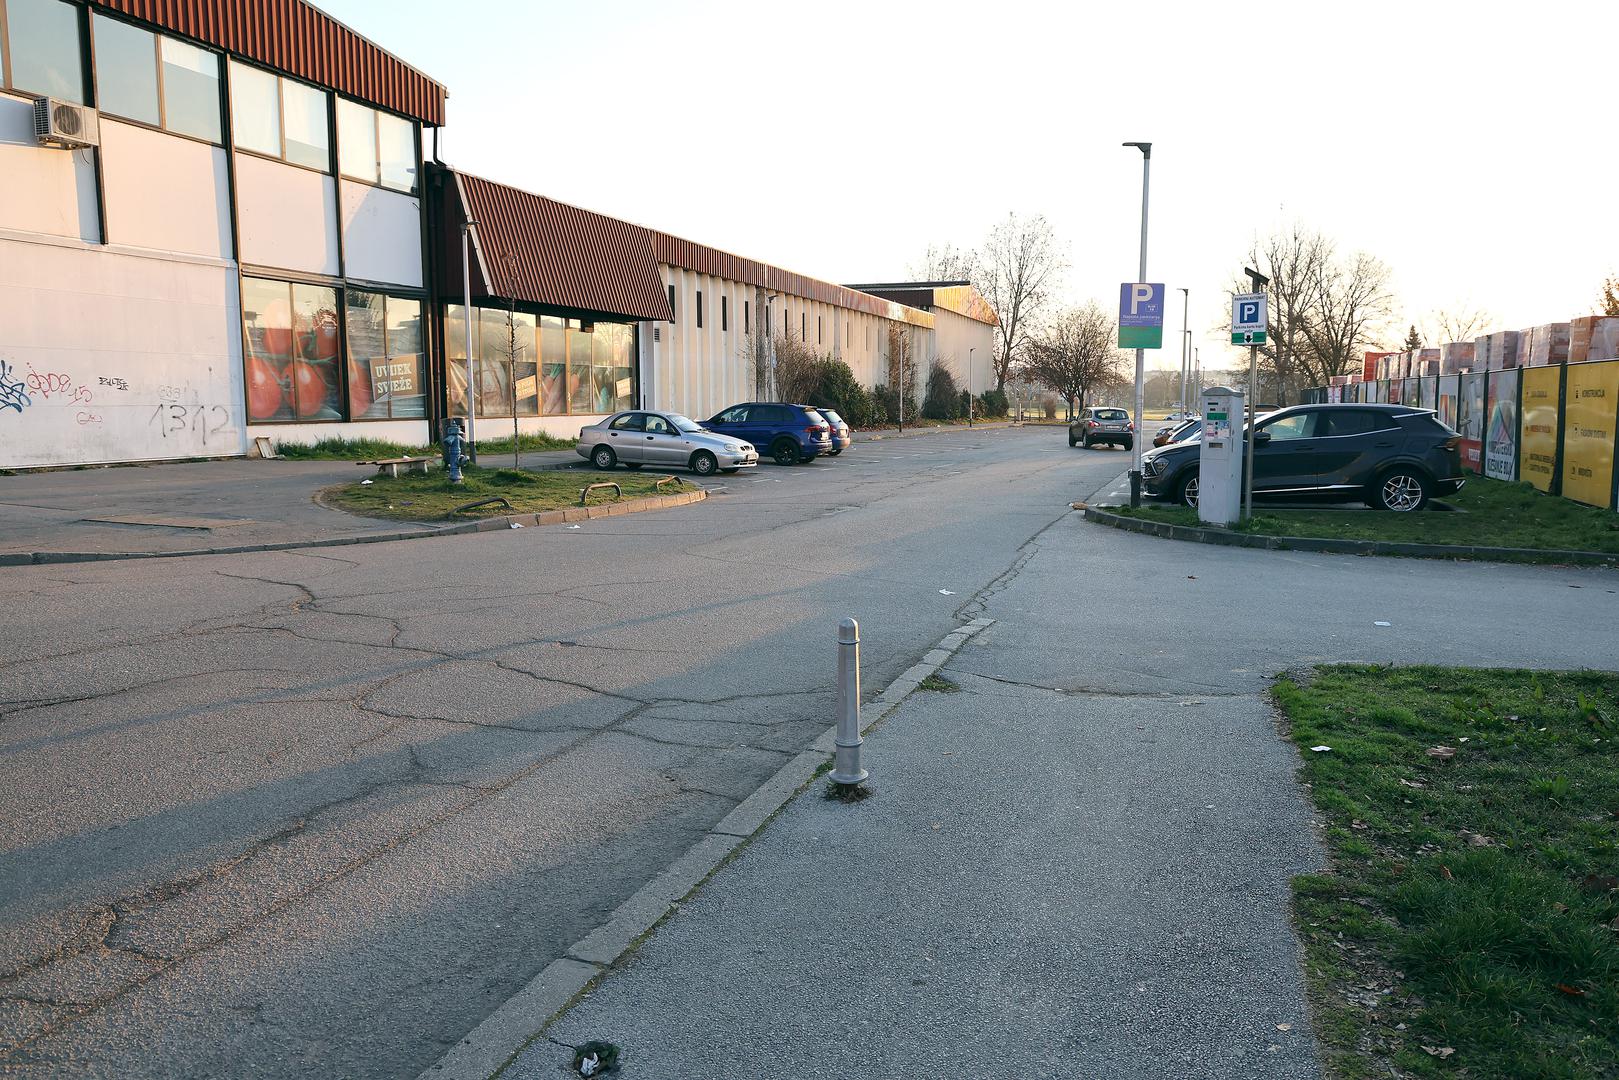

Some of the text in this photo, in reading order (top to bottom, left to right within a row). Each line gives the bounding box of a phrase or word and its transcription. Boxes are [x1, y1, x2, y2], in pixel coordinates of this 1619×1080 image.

[1131, 283, 1153, 315] P
[1244, 304, 1256, 321] P
[149, 403, 238, 446] 1312
